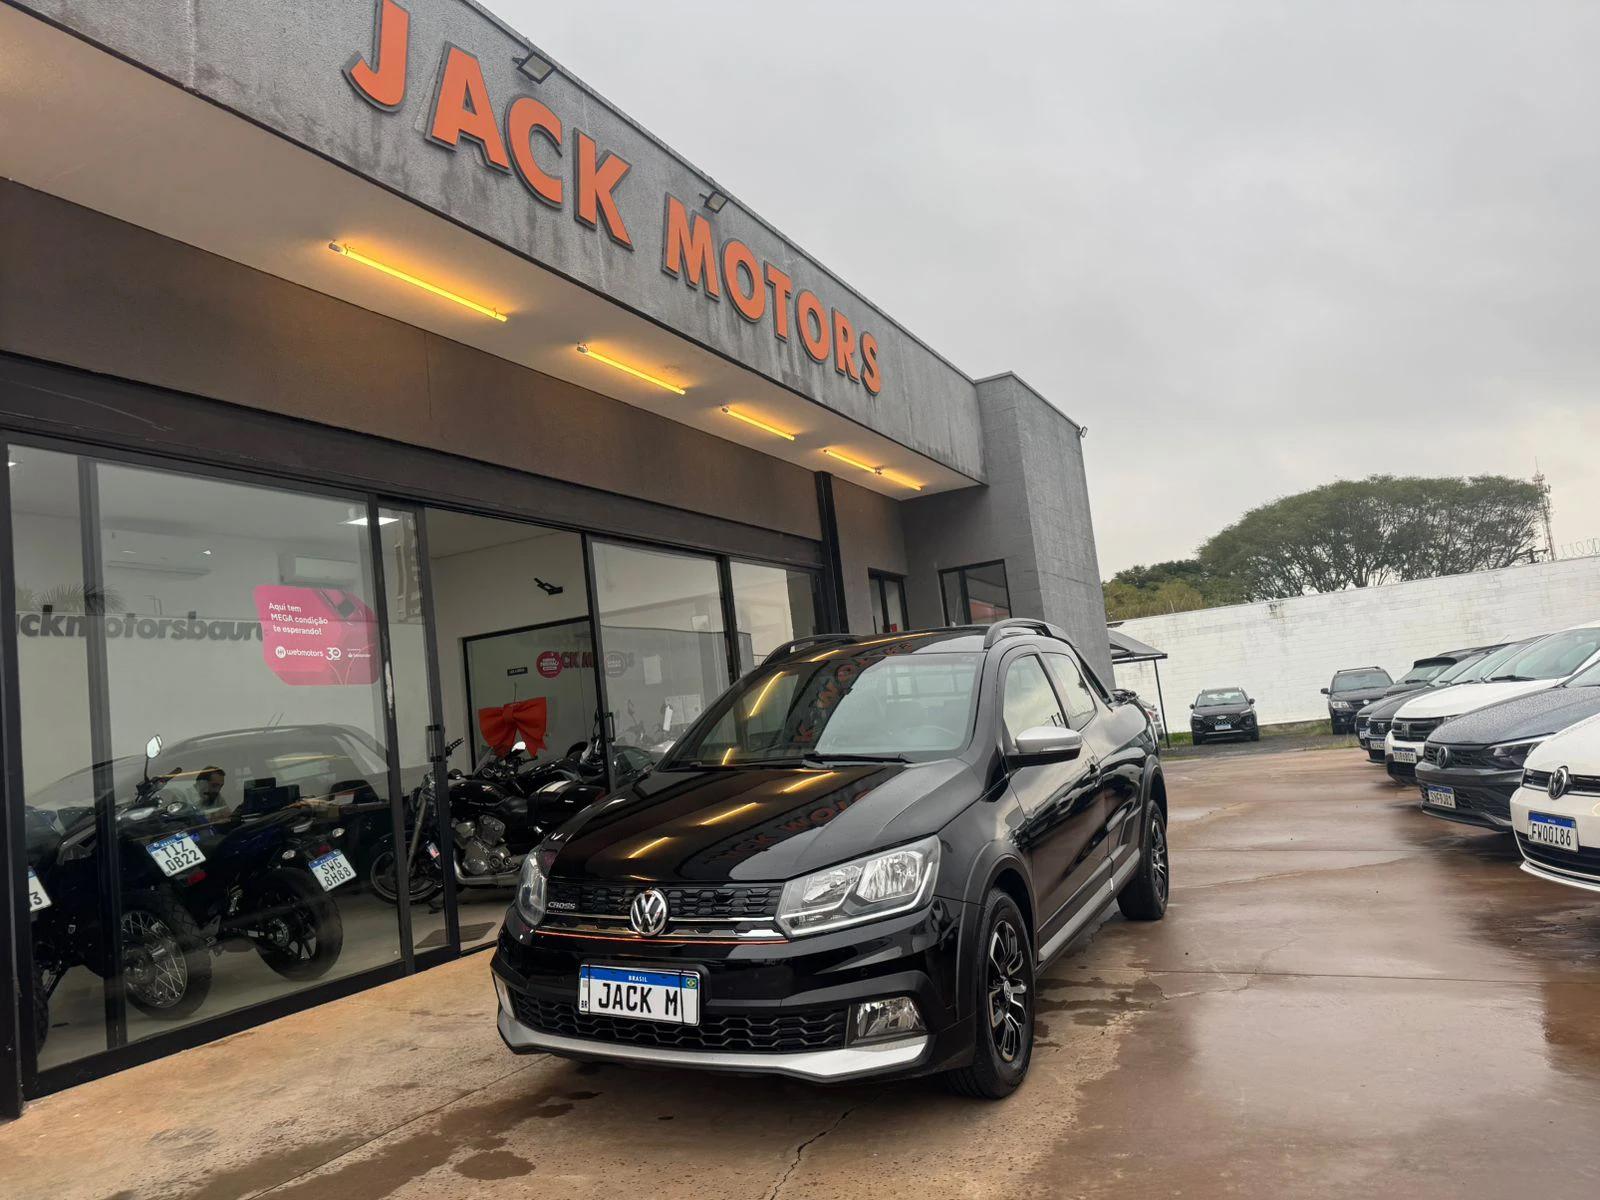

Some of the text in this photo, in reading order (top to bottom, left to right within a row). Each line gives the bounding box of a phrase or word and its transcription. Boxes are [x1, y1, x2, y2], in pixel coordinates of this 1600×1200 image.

[341, 0, 882, 396] JACK MOTORS
[269, 602, 302, 613] Aqui tem
[270, 613, 328, 626] MEGA condição
[272, 624, 322, 635] te esperando!
[286, 648, 324, 657] webmotors
[160, 840, 189, 859] TIZ
[320, 858, 342, 875] SWG
[324, 867, 351, 887] 8H88
[598, 983, 678, 1016] JACK M
